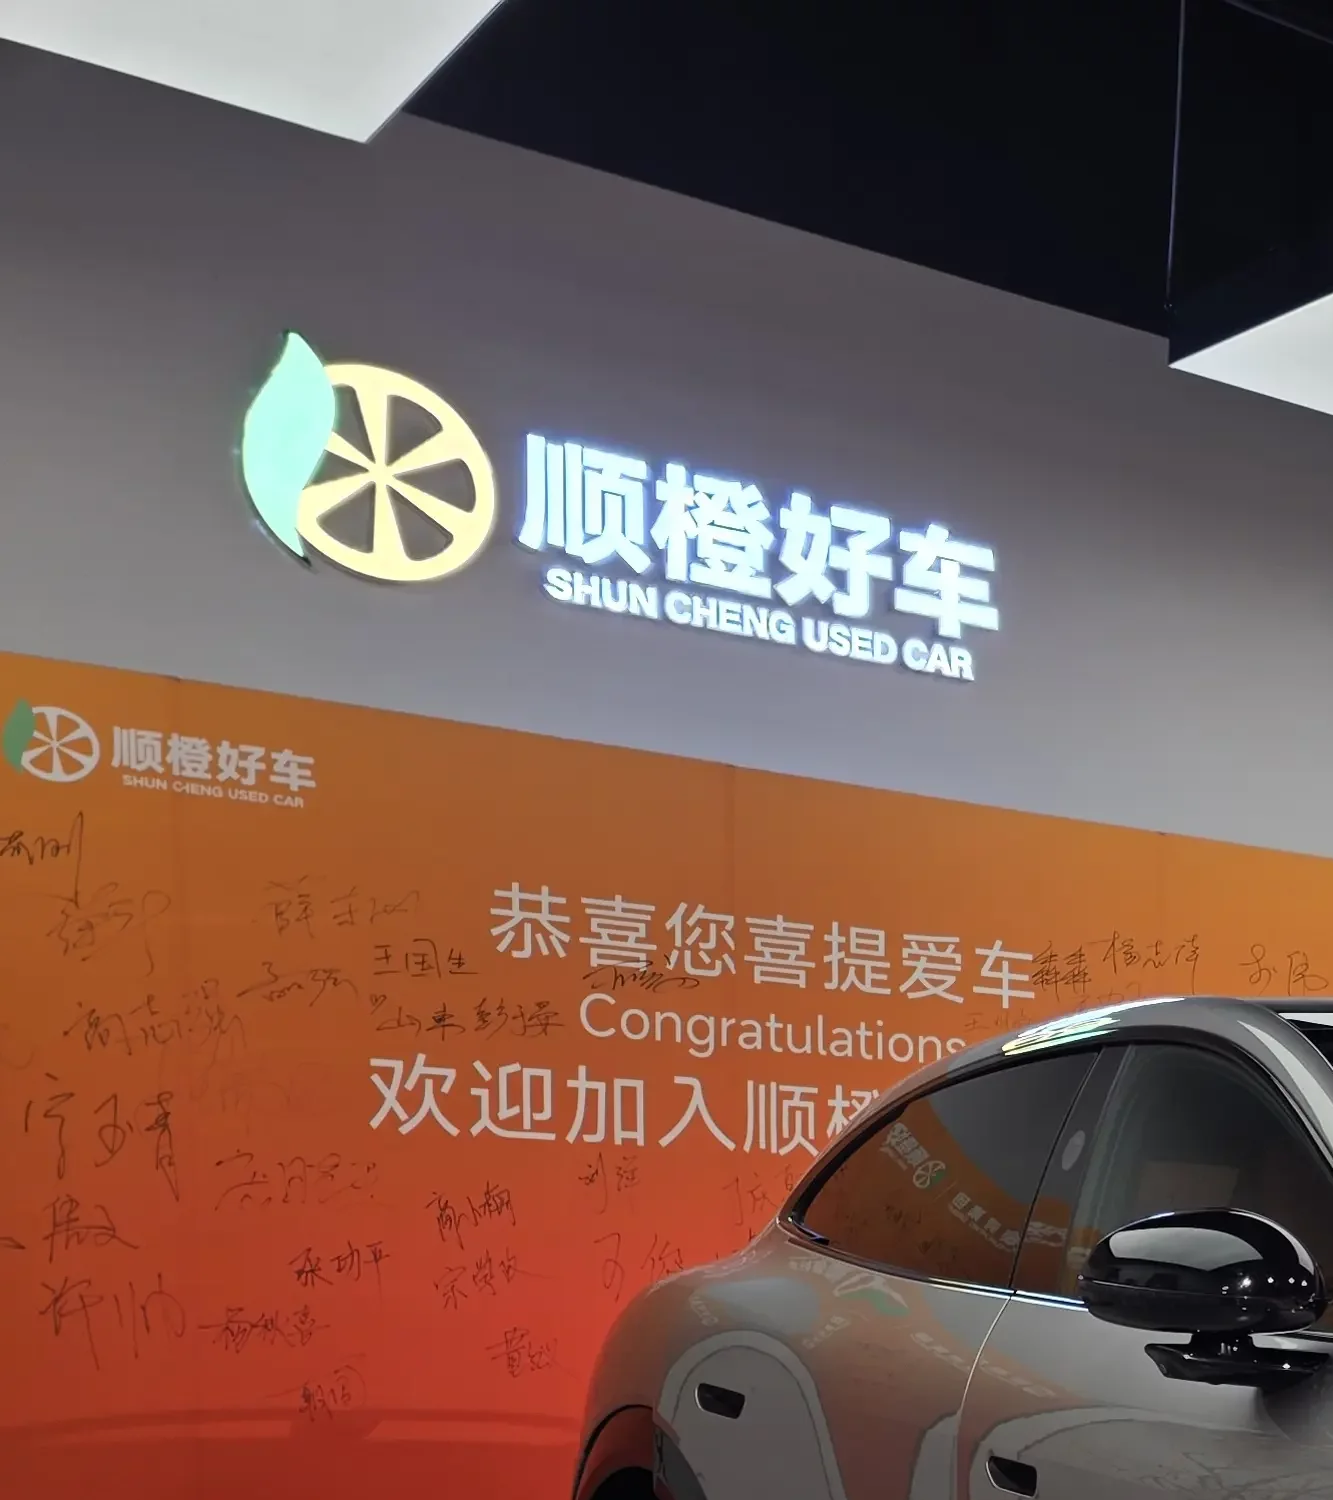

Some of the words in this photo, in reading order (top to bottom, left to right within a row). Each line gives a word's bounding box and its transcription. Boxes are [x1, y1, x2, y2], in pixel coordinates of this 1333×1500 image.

[518, 433, 999, 639] 顺橙好车
[545, 568, 659, 619] SHUN
[664, 591, 796, 644] CHENG
[801, 616, 898, 664] USED
[902, 638, 975, 681] CAR
[111, 726, 316, 792] 顺橙好车
[122, 775, 168, 791] SHUN
[173, 780, 223, 798] CHENG
[228, 787, 269, 804] USED
[273, 794, 304, 808] CAR
[489, 881, 1036, 1009] 恭喜您喜提爱车
